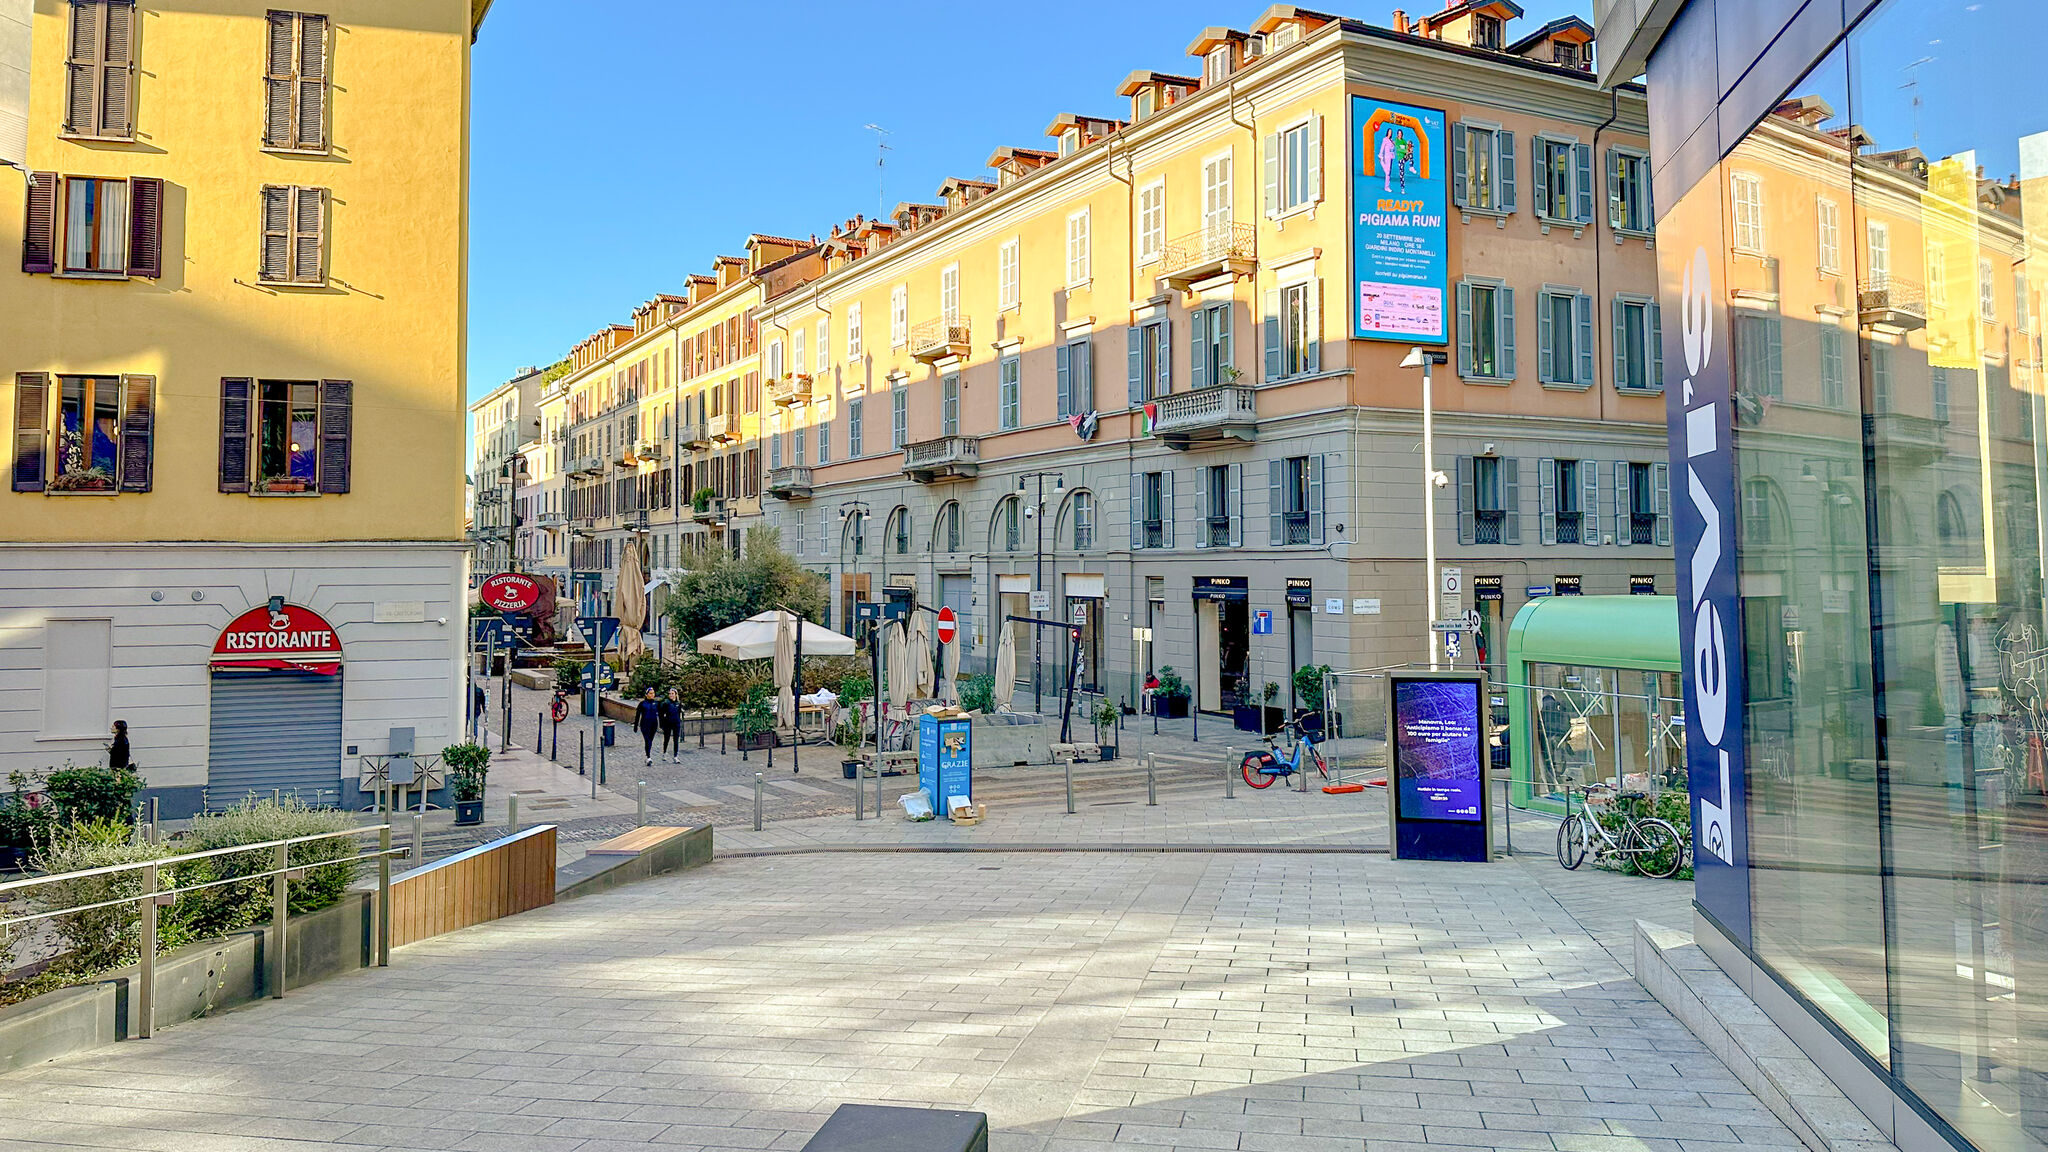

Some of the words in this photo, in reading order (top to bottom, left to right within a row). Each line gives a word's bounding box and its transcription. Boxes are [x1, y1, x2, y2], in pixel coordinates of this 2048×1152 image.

[1377, 199, 1424, 212] READY?
[1360, 213, 1410, 227] PIGIAMA
[1412, 214, 1441, 227] RUN!
[1380, 239, 1400, 247] MILANO
[1383, 233, 1413, 242] SETTEMBRE
[1365, 243, 1387, 251] GIARDINI
[1405, 248, 1436, 257] MONTANELLI
[490, 576, 533, 589] RISTORANTE
[494, 598, 527, 608] PIZZERIA
[226, 631, 331, 649] RISTORANTE
[941, 760, 968, 769] GRAZIE
